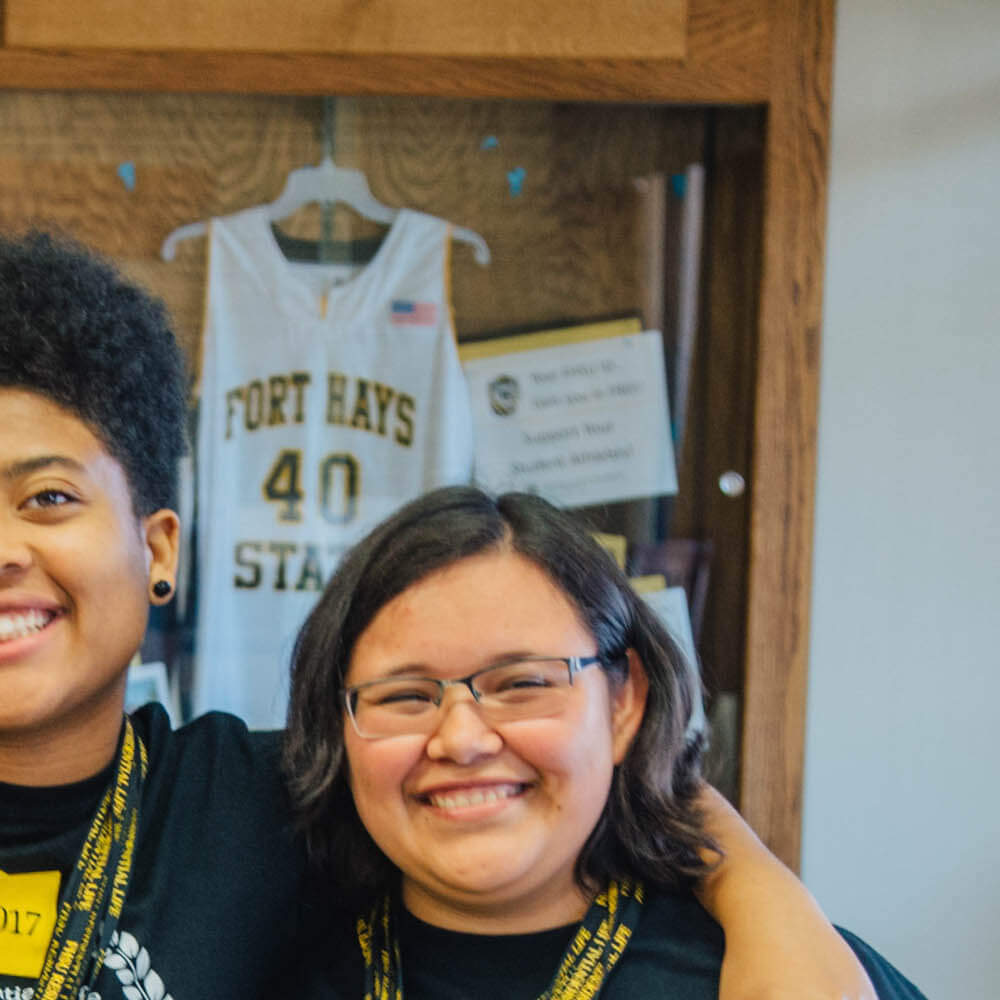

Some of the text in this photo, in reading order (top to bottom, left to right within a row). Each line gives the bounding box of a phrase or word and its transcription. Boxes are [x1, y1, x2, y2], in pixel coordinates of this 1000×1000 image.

[226, 371, 416, 448] FORT HAYS
[262, 447, 361, 526] 40
[233, 540, 332, 592] STA
[108, 888, 125, 918] LIFE
[53, 937, 79, 973] FHSU
[566, 926, 593, 955] LIFE
[607, 924, 634, 953] LIFE
